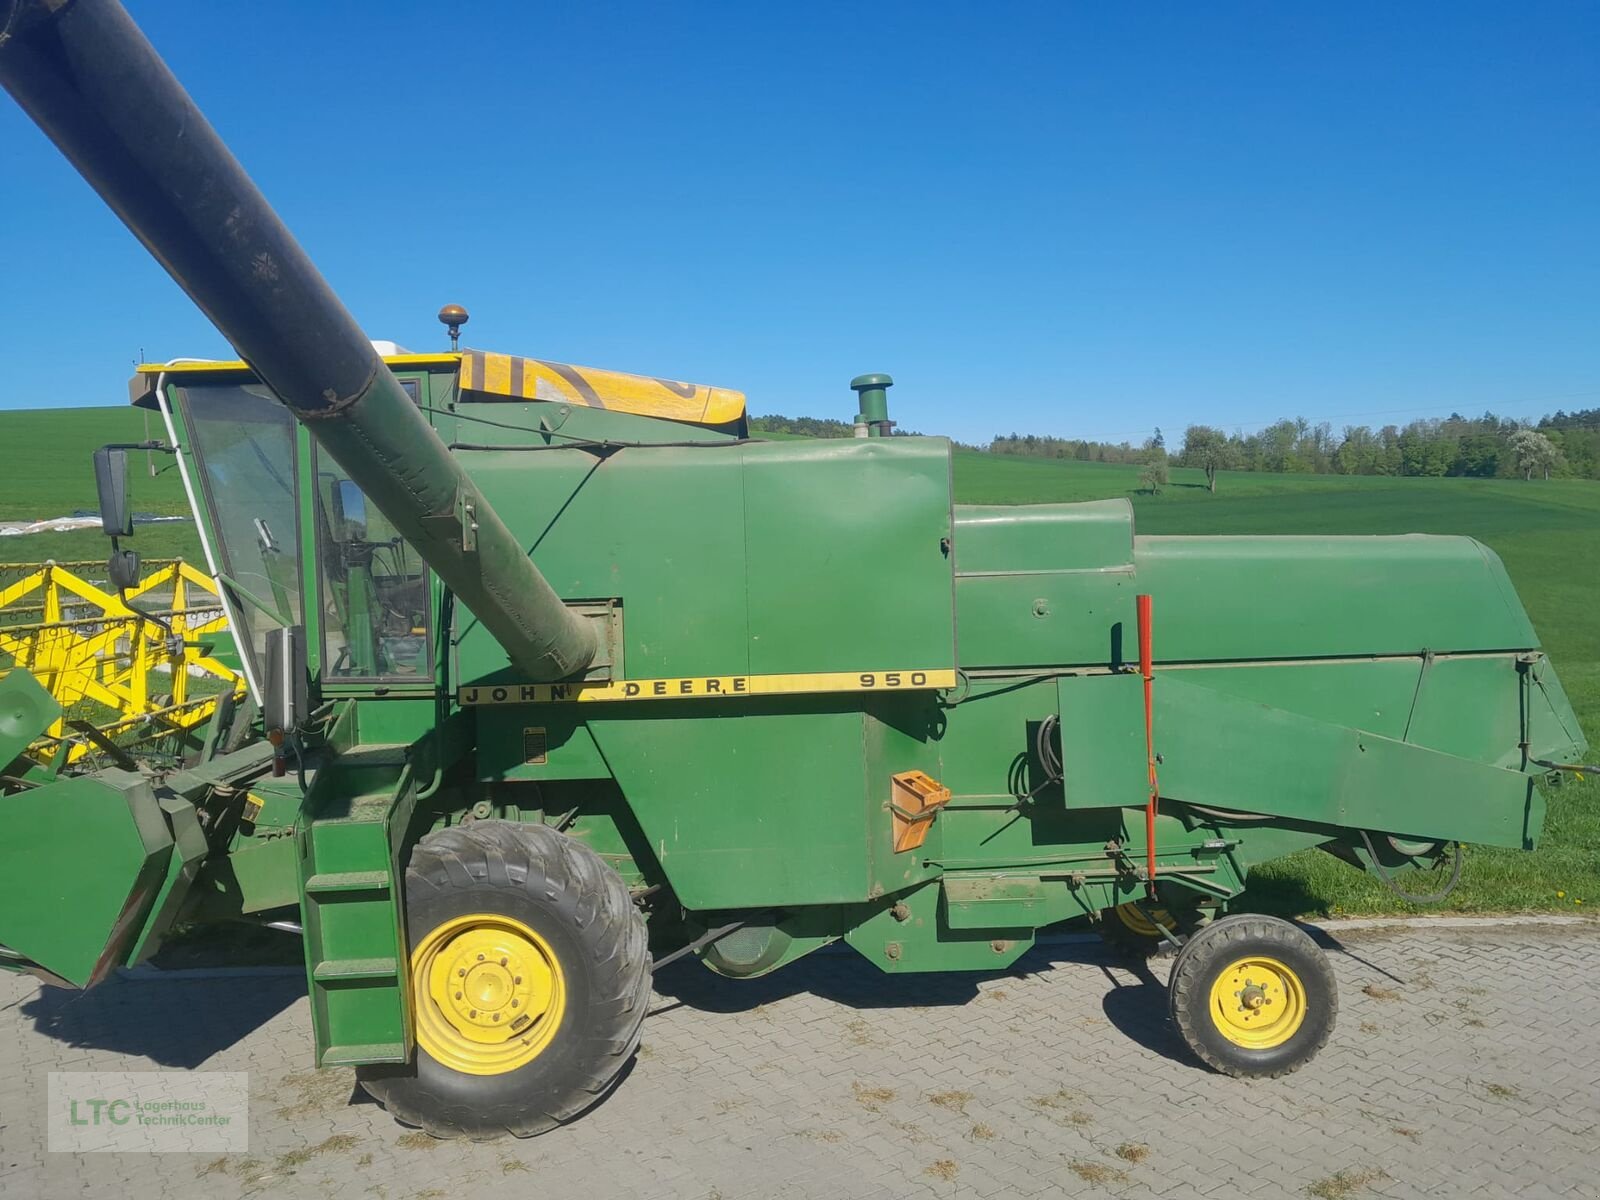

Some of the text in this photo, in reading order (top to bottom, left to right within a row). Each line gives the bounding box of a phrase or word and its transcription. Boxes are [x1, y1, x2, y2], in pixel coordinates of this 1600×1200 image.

[465, 672, 927, 703] JOHN DEERE 950
